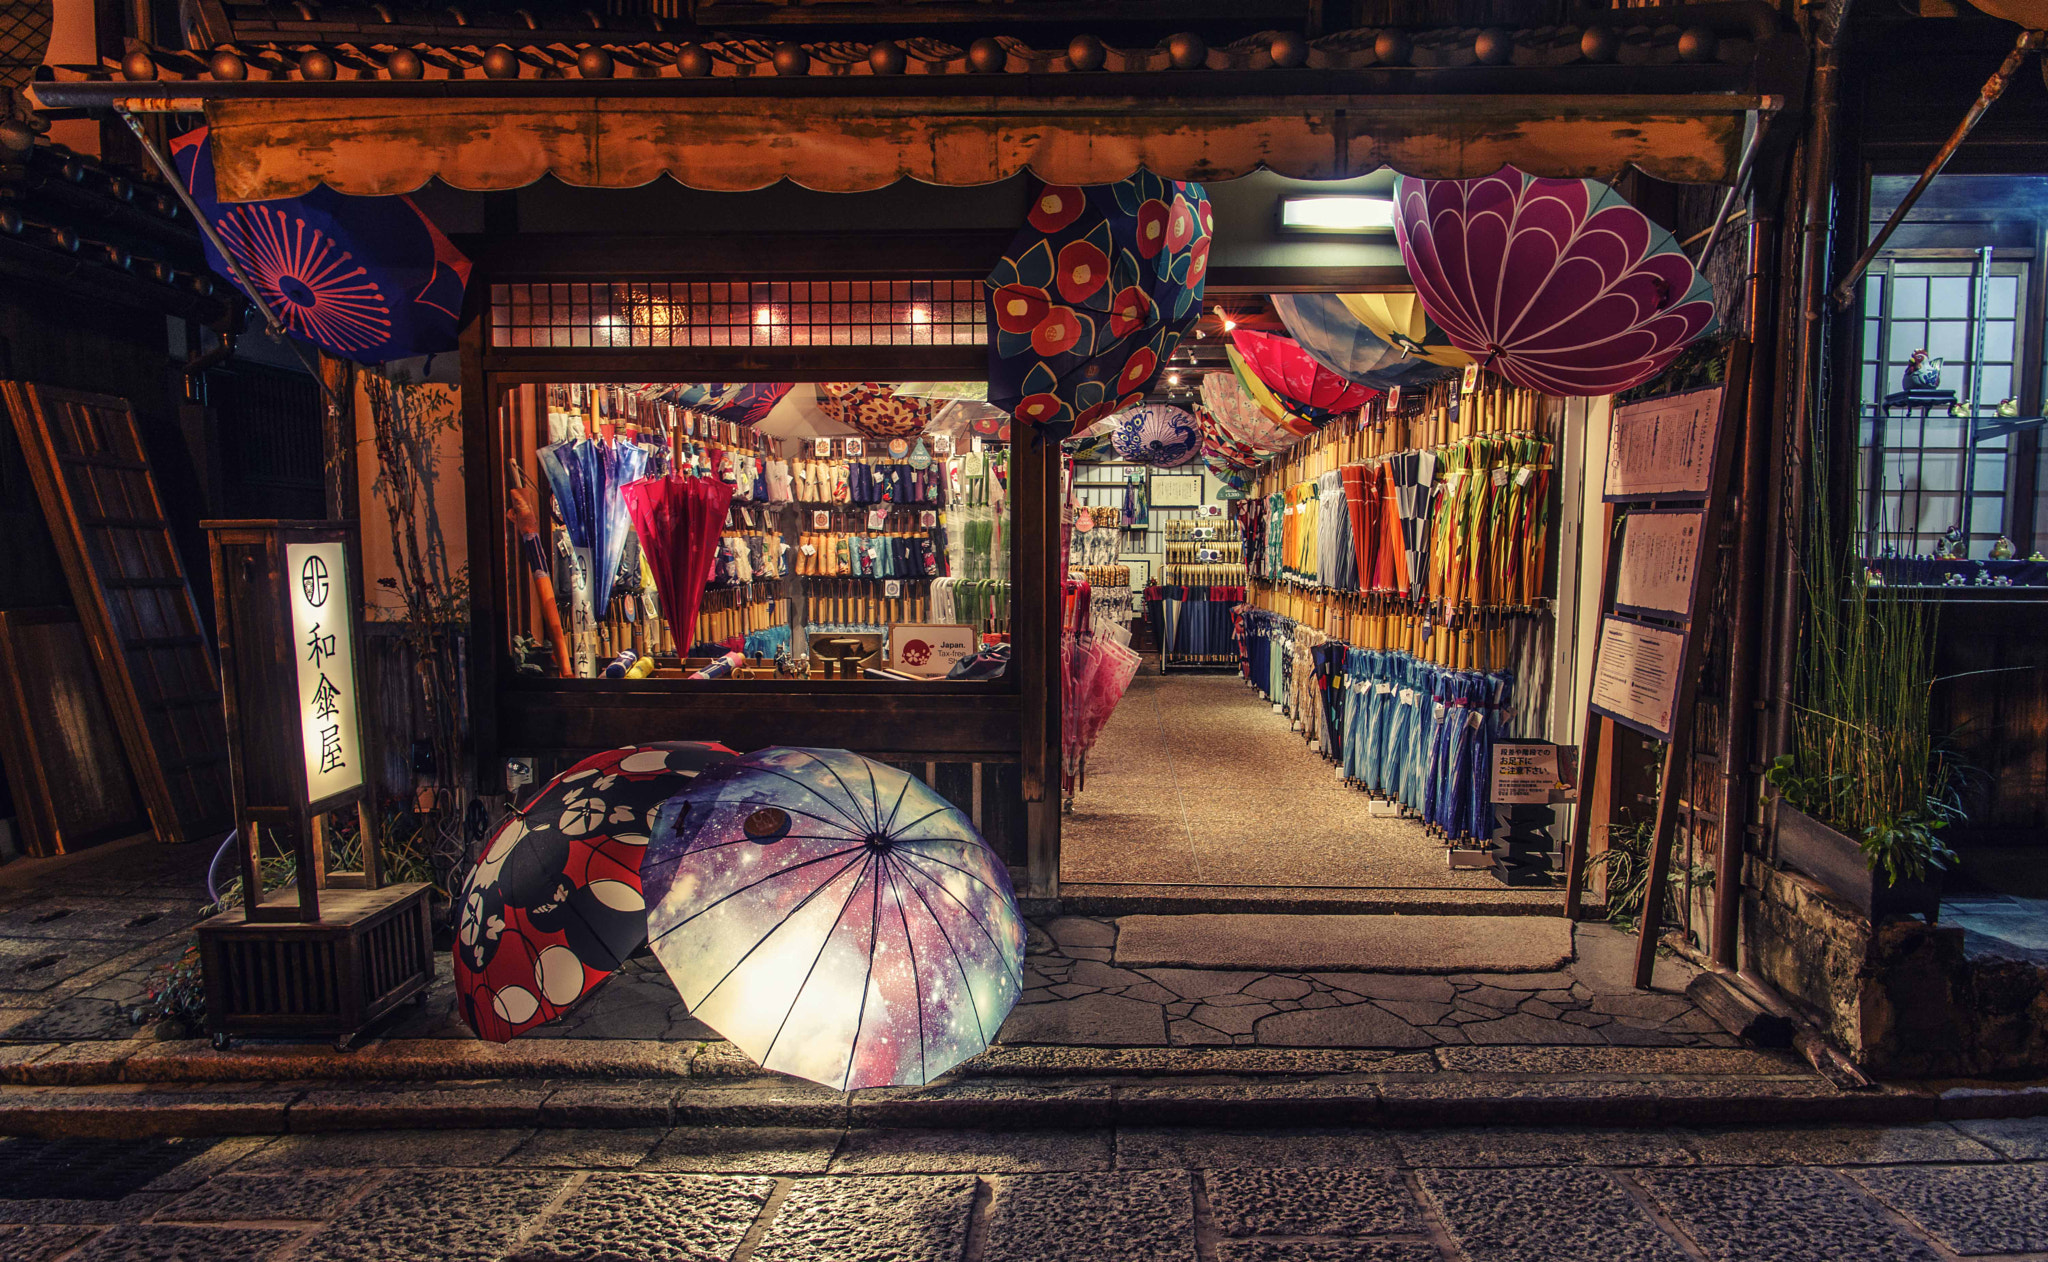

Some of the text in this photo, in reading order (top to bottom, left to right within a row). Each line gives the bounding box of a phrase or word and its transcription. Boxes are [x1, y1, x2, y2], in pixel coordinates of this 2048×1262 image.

[940, 641, 966, 649] Japan.
[307, 622, 346, 775] 和傘屋
[1500, 757, 1533, 766] お足下に
